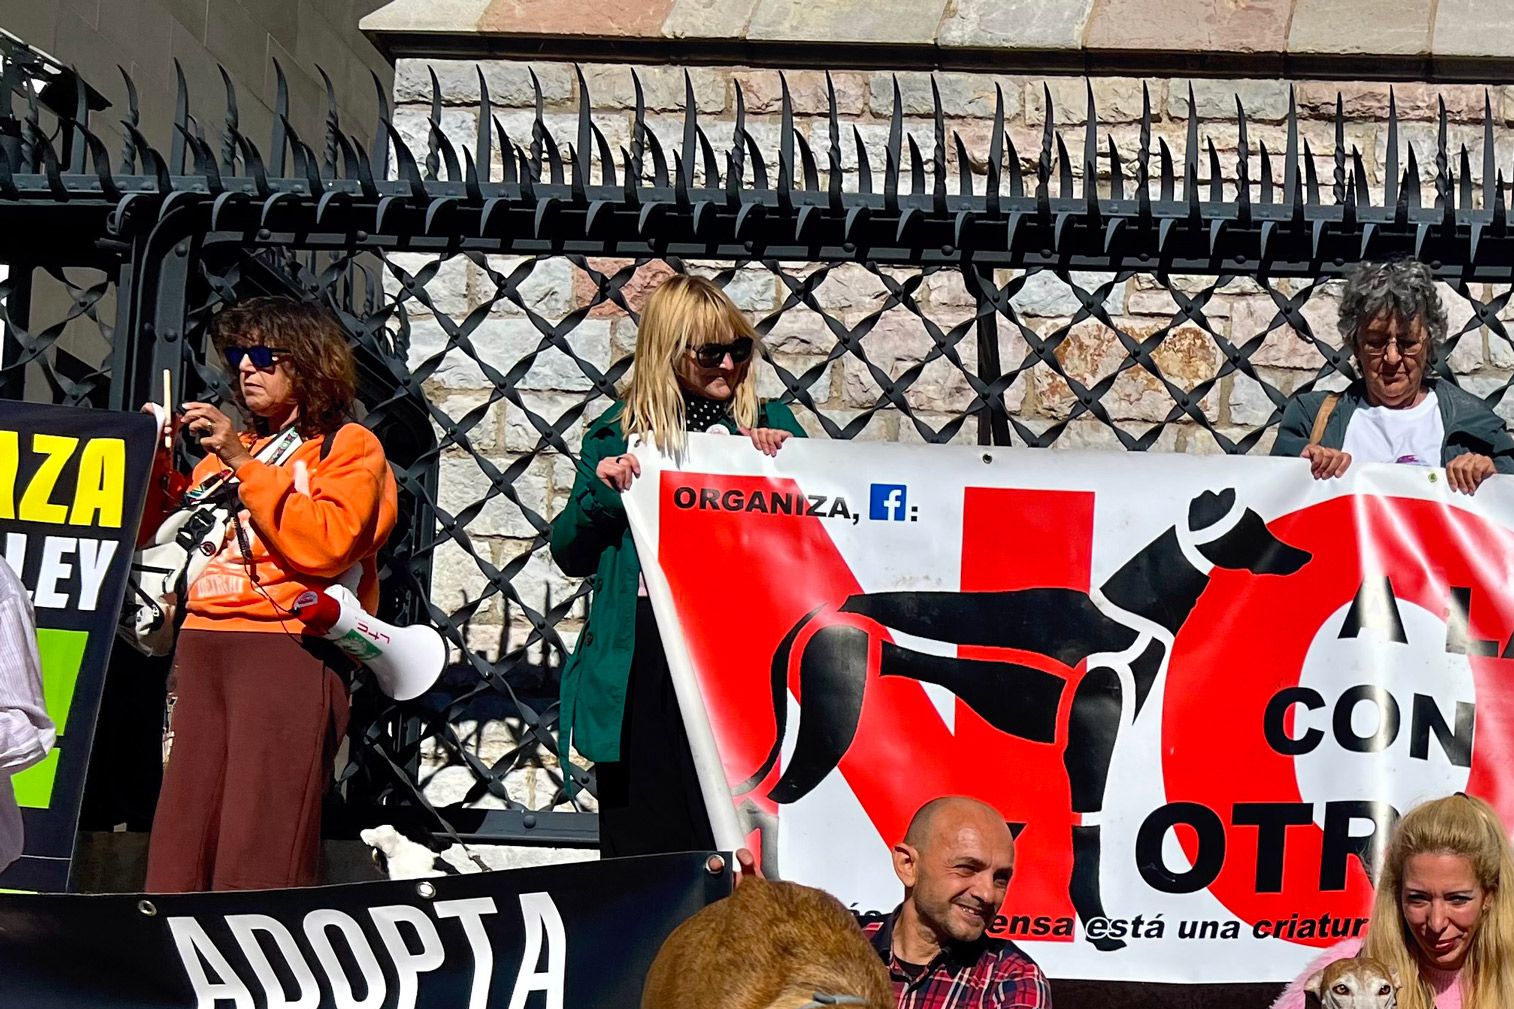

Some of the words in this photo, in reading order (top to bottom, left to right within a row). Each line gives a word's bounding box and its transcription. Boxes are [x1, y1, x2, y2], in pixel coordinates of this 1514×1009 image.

[673, 486, 860, 525] ORGANIZA,
[1338, 574, 1408, 644] A
[1263, 684, 1475, 768] CON
[1087, 913, 1163, 940] está
[1177, 918, 1240, 939] una
[1252, 912, 1369, 939] criatur
